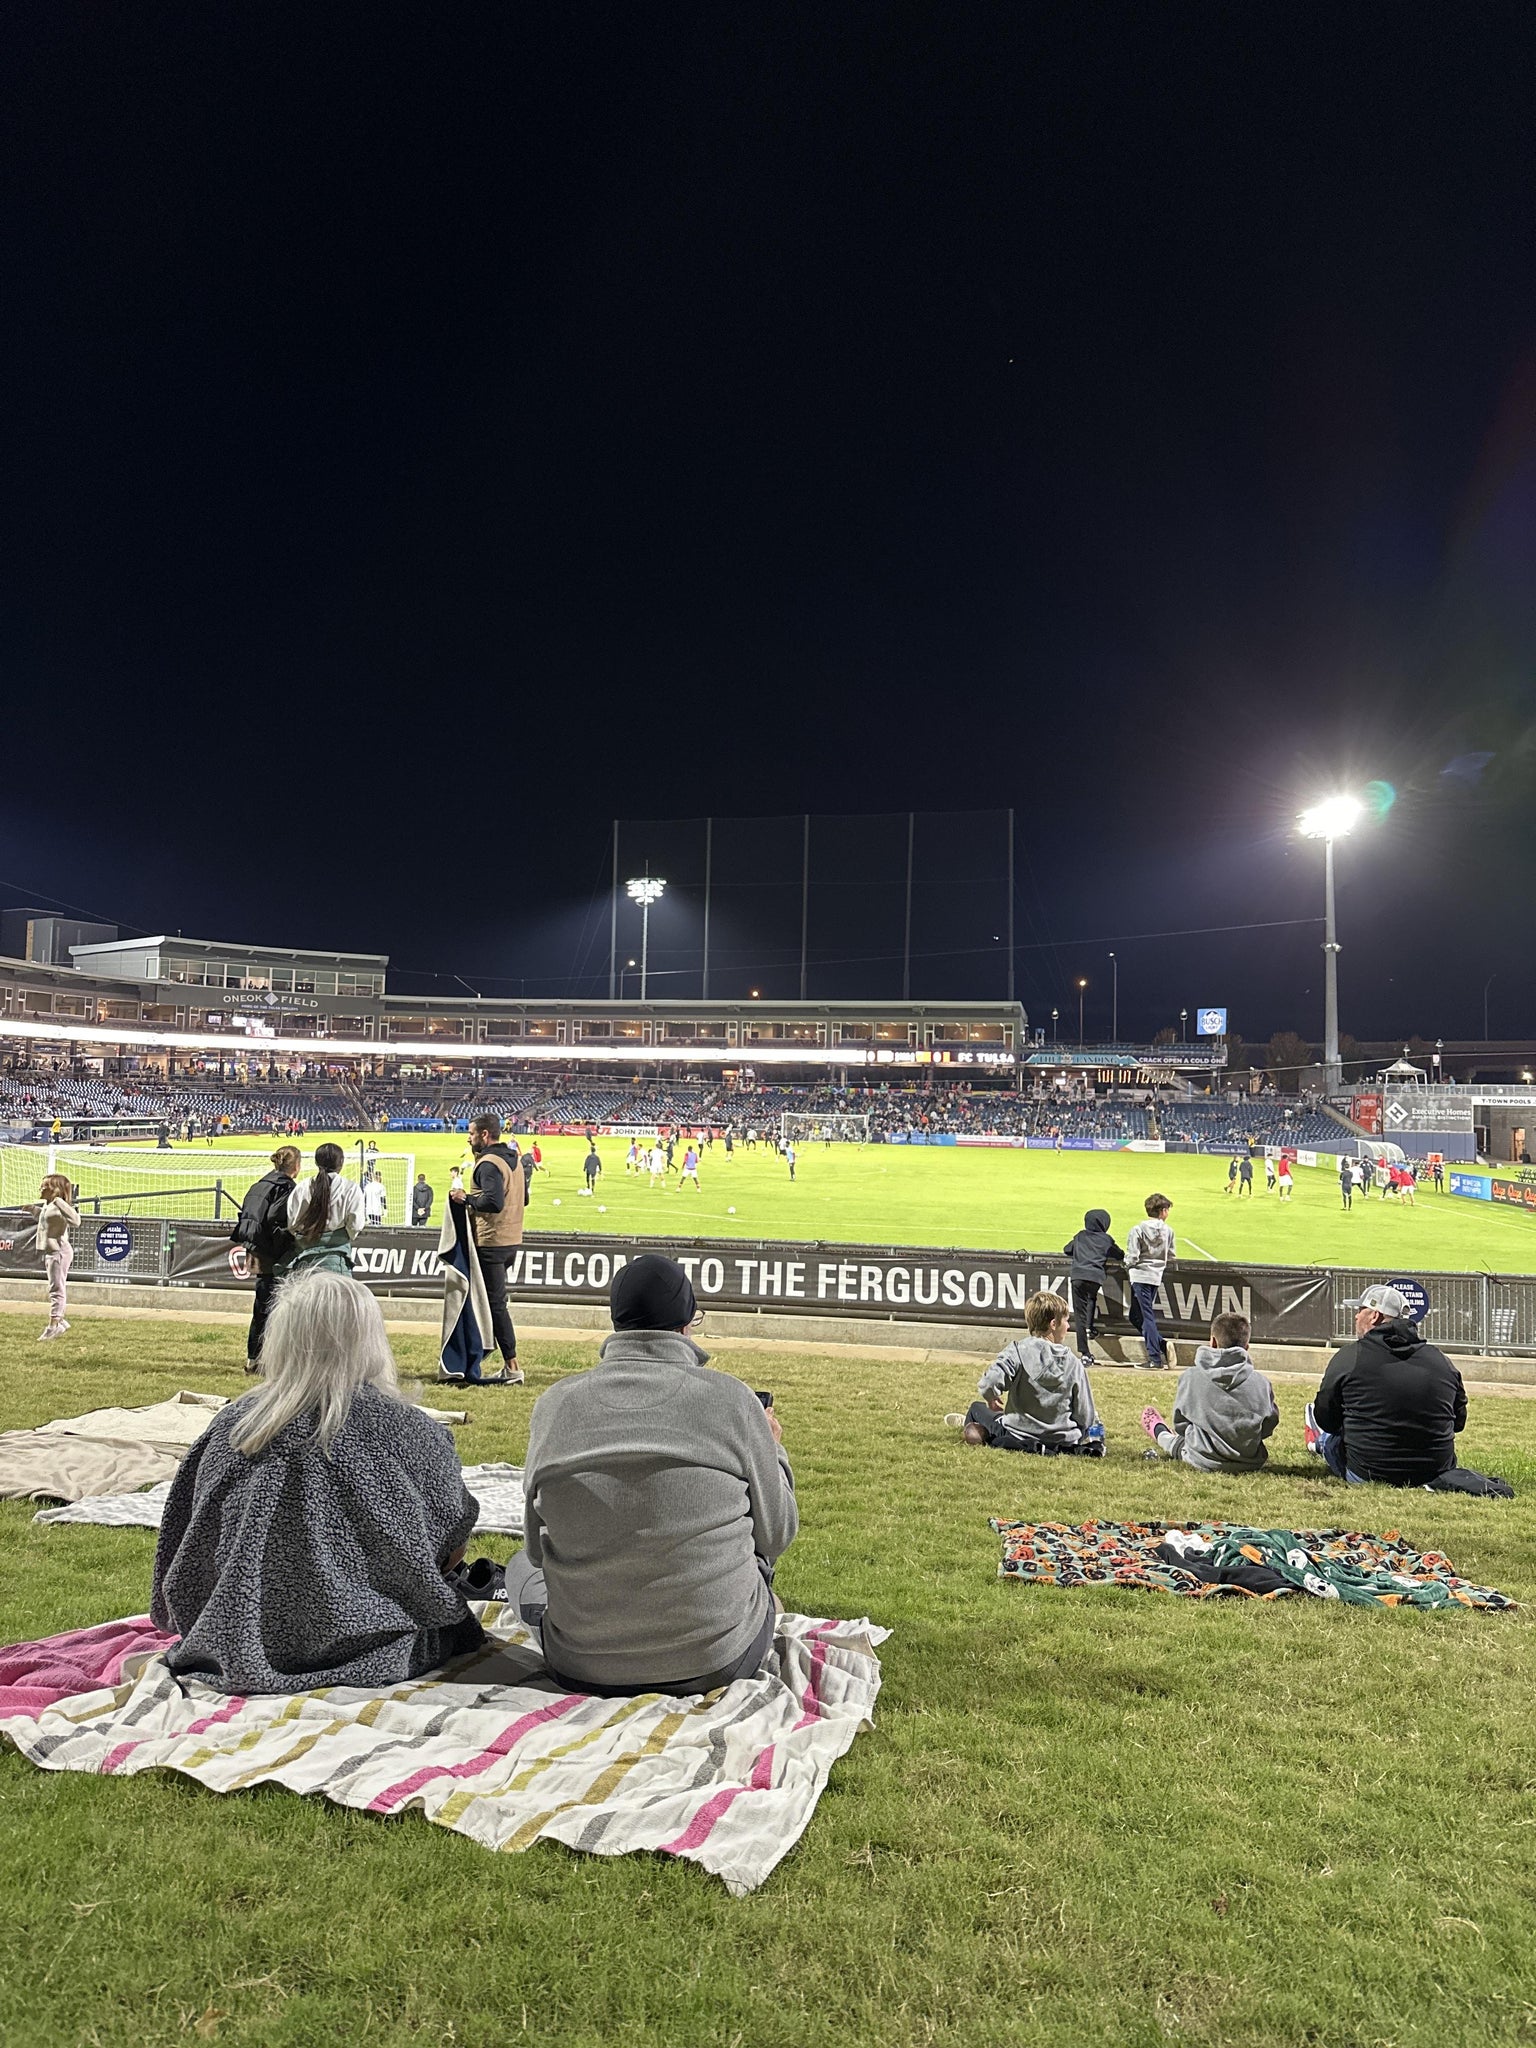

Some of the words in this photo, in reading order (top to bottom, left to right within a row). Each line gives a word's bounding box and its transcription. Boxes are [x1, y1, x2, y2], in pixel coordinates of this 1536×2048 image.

[223, 994, 263, 1003] ONEOK
[281, 996, 319, 1008] FIELD
[1202, 1017, 1223, 1026] BUSCH
[957, 1052, 973, 1063] FC
[976, 1052, 1015, 1063] TULSA
[1411, 1107, 1446, 1116] Executive
[1446, 1108, 1471, 1116] Homes
[677, 1257, 725, 1294] TO
[735, 1259, 806, 1297] THE
[817, 1262, 1026, 1310] FERGUSON
[492, 1588, 509, 1600] HO
